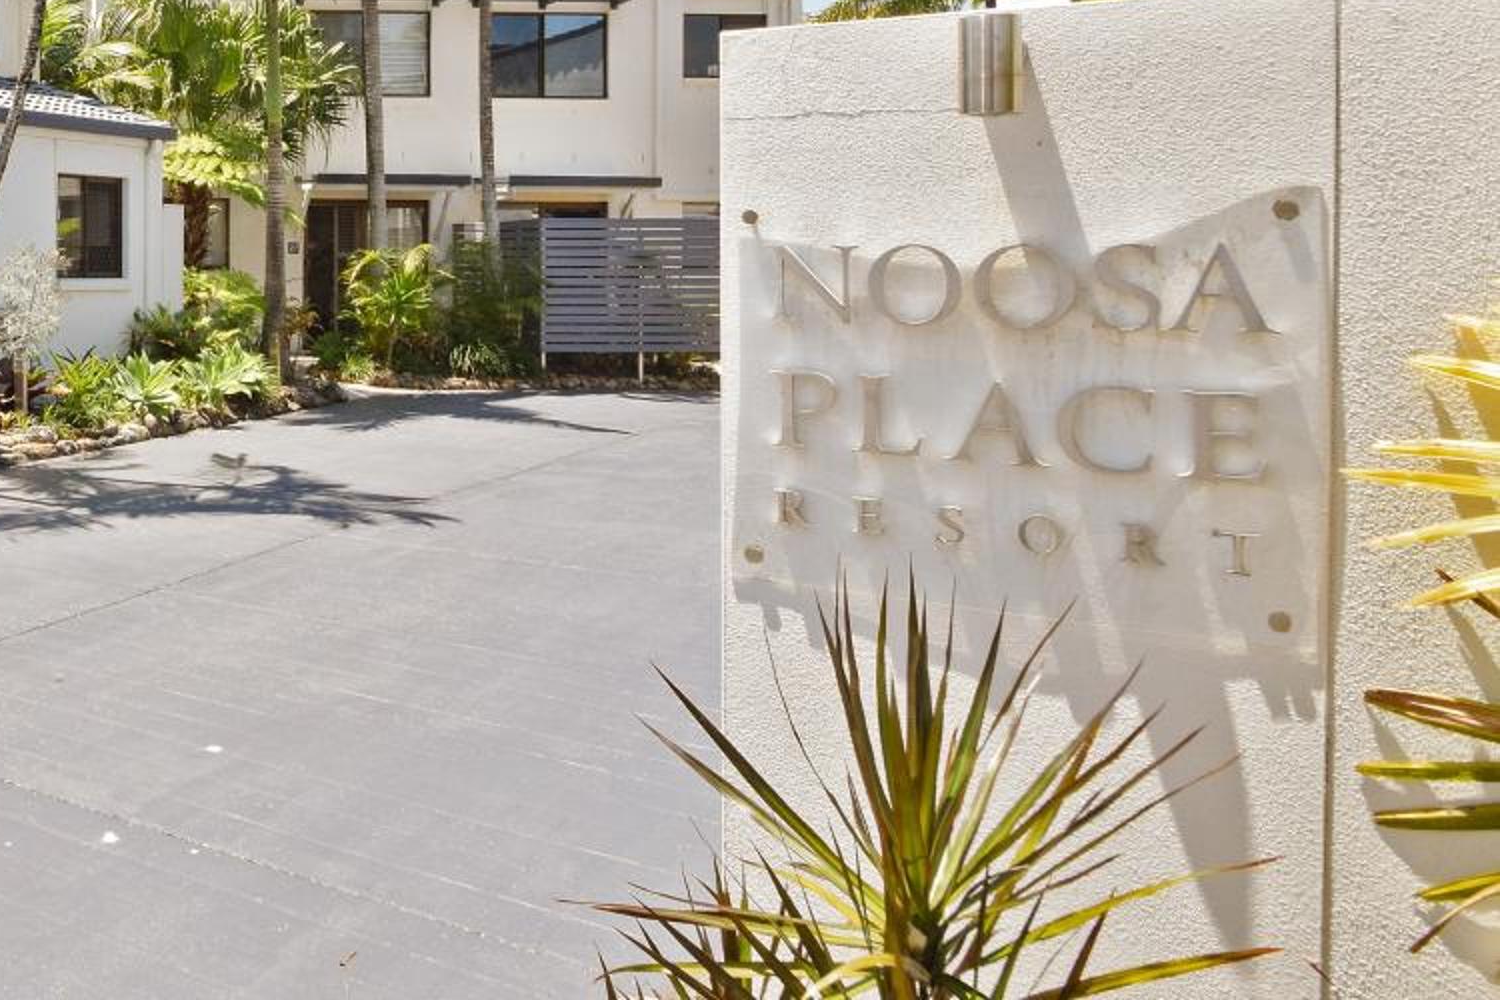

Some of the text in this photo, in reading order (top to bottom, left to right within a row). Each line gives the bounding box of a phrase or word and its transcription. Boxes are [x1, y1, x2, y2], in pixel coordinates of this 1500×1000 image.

[771, 242, 1283, 336] NOOSA
[767, 368, 1270, 482] PLACE
[771, 487, 1263, 578] RESORT
